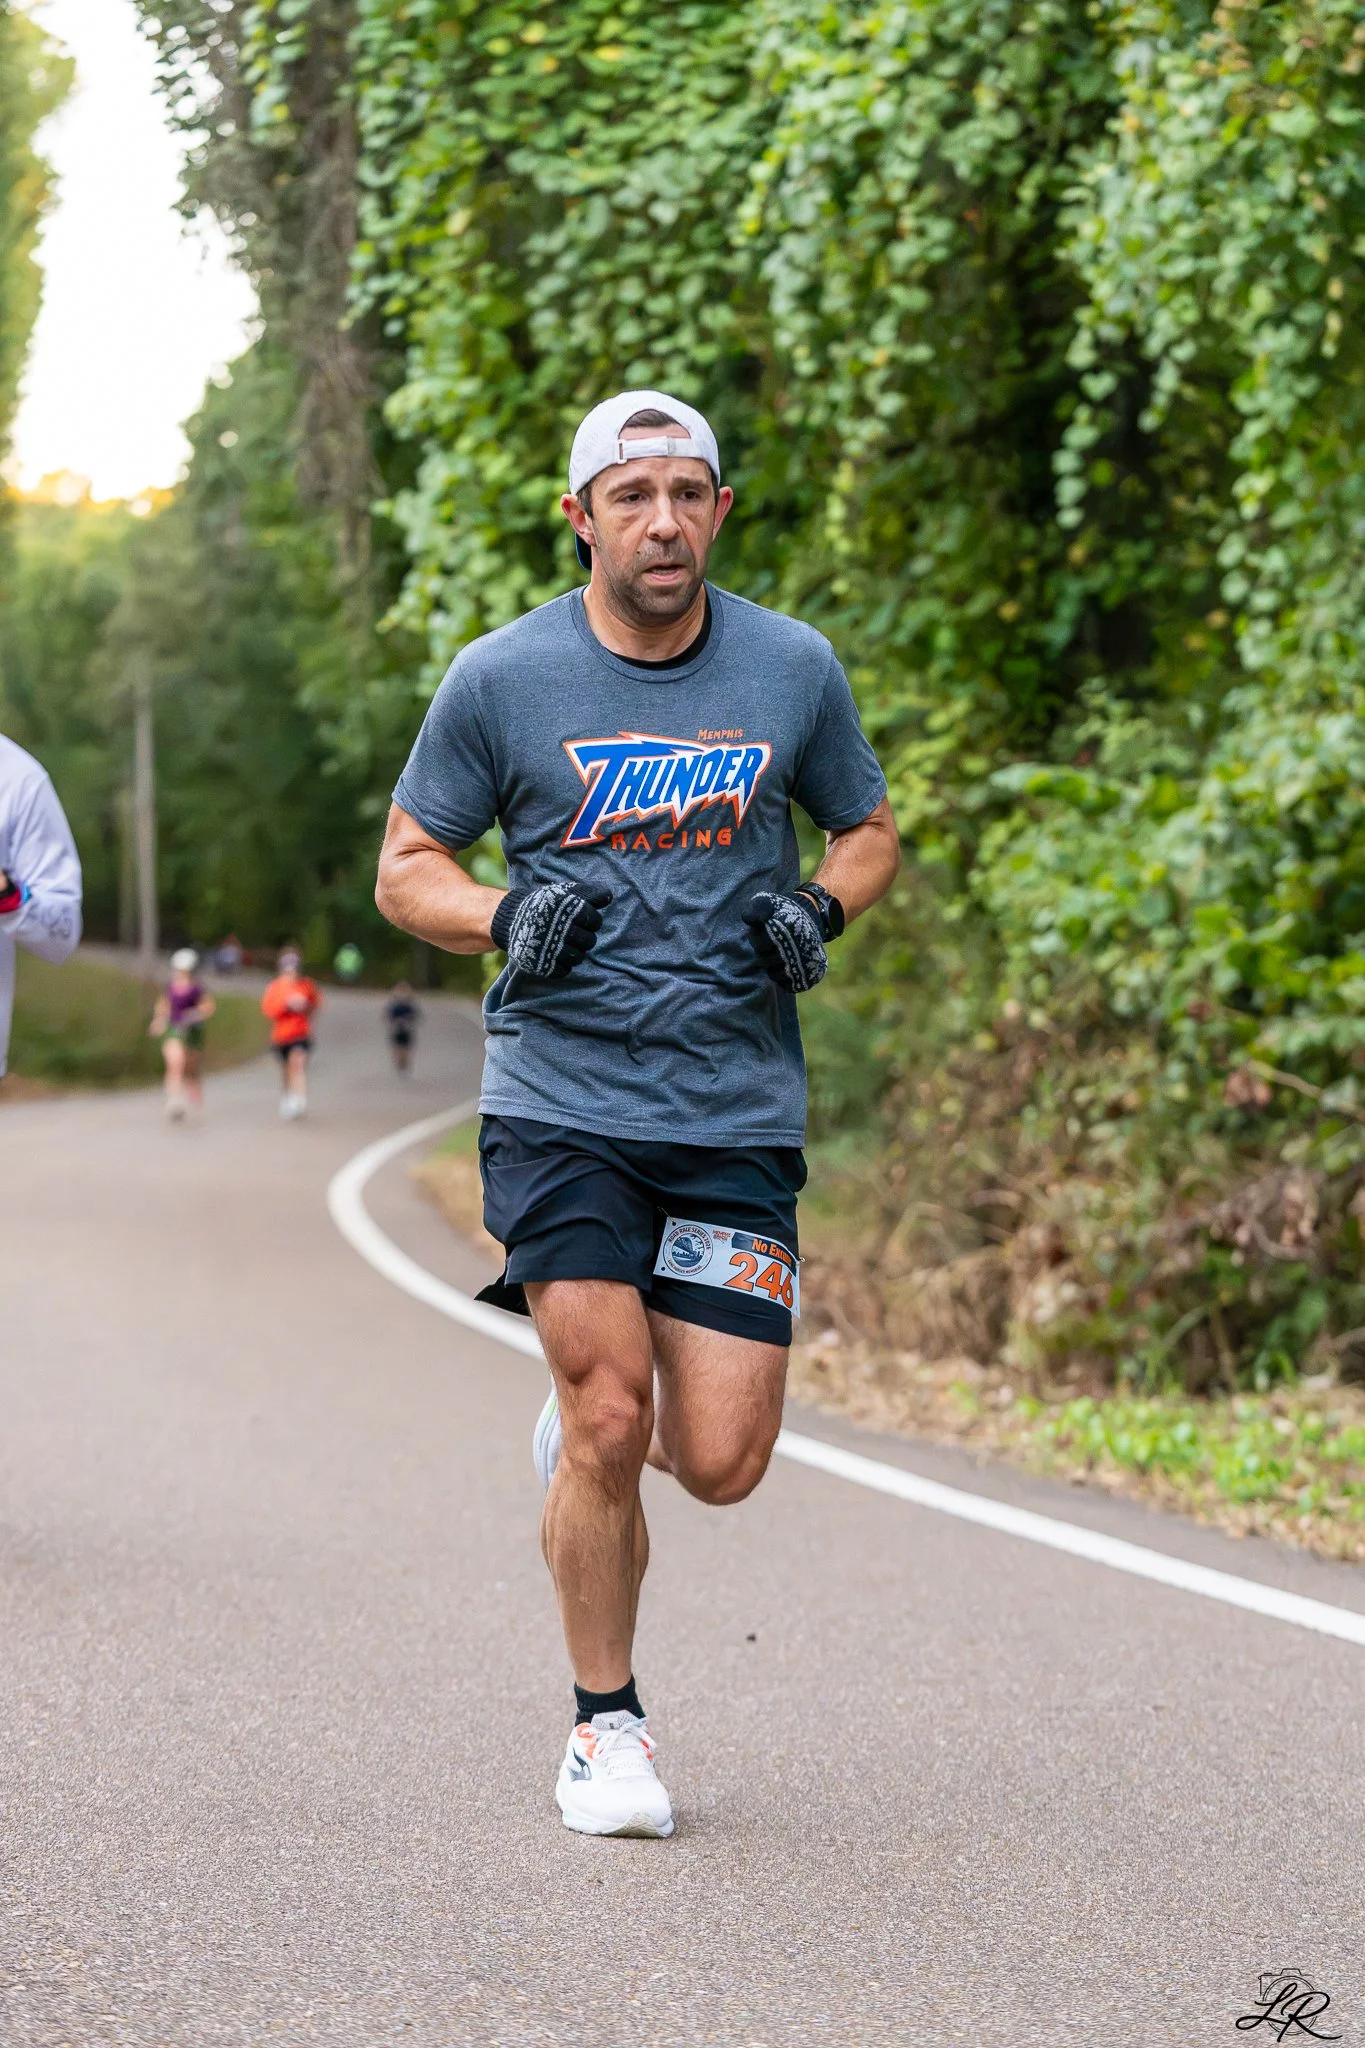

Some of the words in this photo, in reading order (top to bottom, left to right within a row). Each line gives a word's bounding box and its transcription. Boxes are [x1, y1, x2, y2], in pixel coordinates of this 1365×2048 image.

[697, 728, 744, 741] MEMPHIS
[560, 731, 772, 848] THUNDER
[610, 827, 733, 851] RACING
[679, 1226, 690, 1234] RACE
[690, 1227, 705, 1239] SERIES
[723, 1251, 794, 1308] 246
